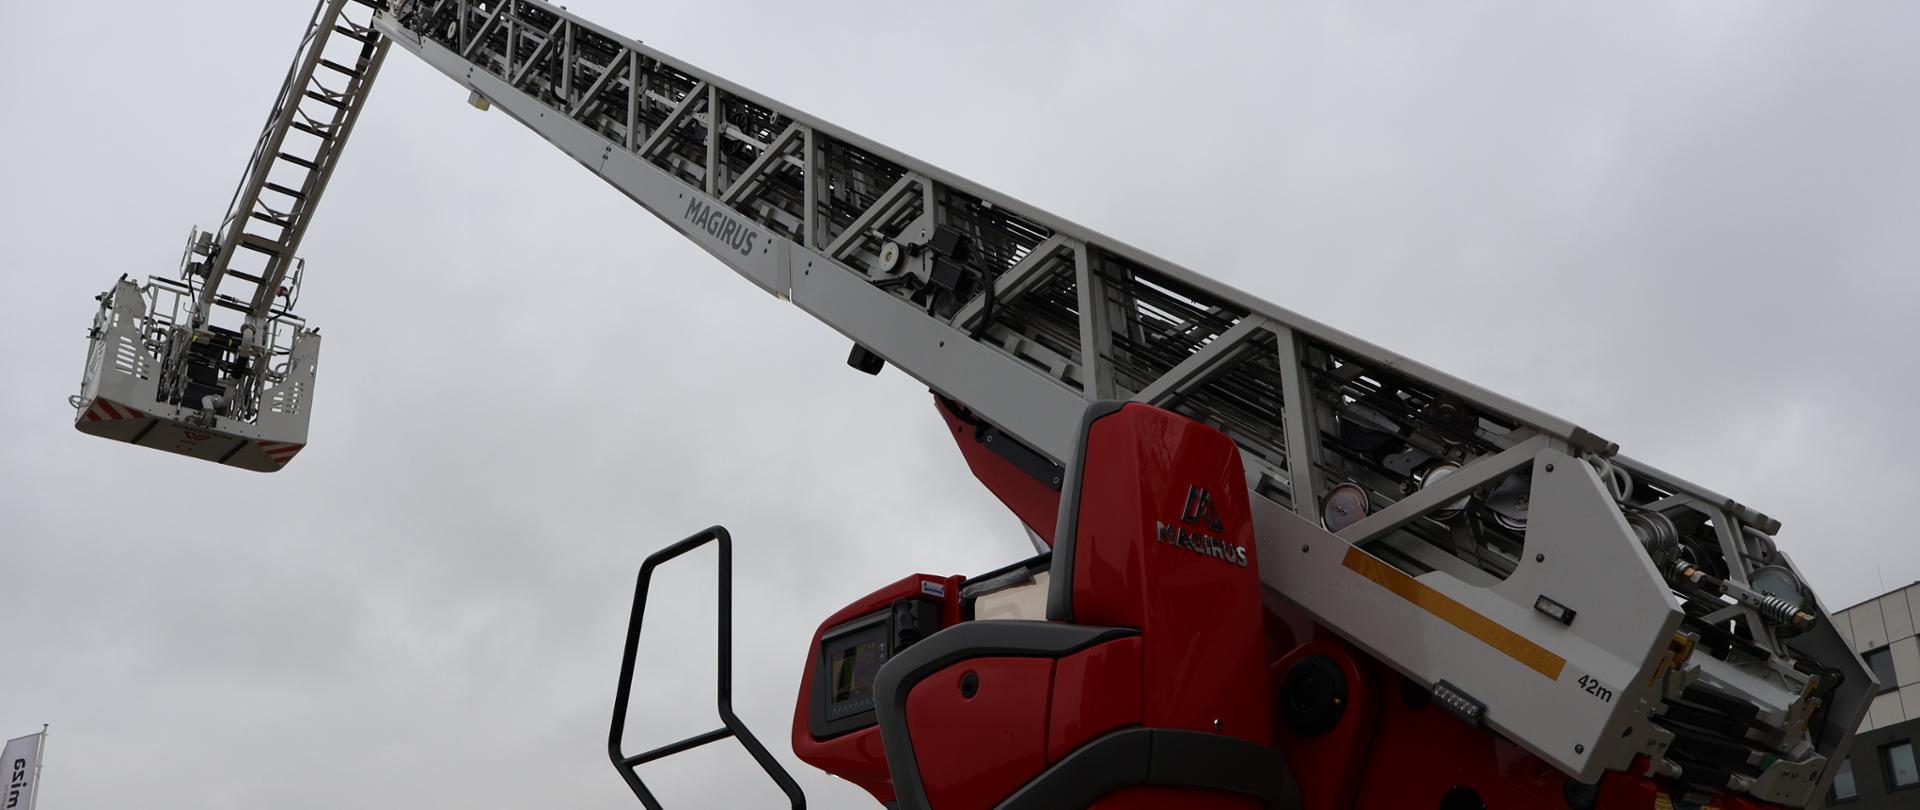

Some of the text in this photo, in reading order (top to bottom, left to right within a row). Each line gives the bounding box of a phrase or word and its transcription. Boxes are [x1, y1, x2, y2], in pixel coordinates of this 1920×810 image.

[684, 197, 758, 256] MAGIRUS
[1156, 520, 1248, 568] MAGIRUS
[1577, 674, 1612, 703] 42m
